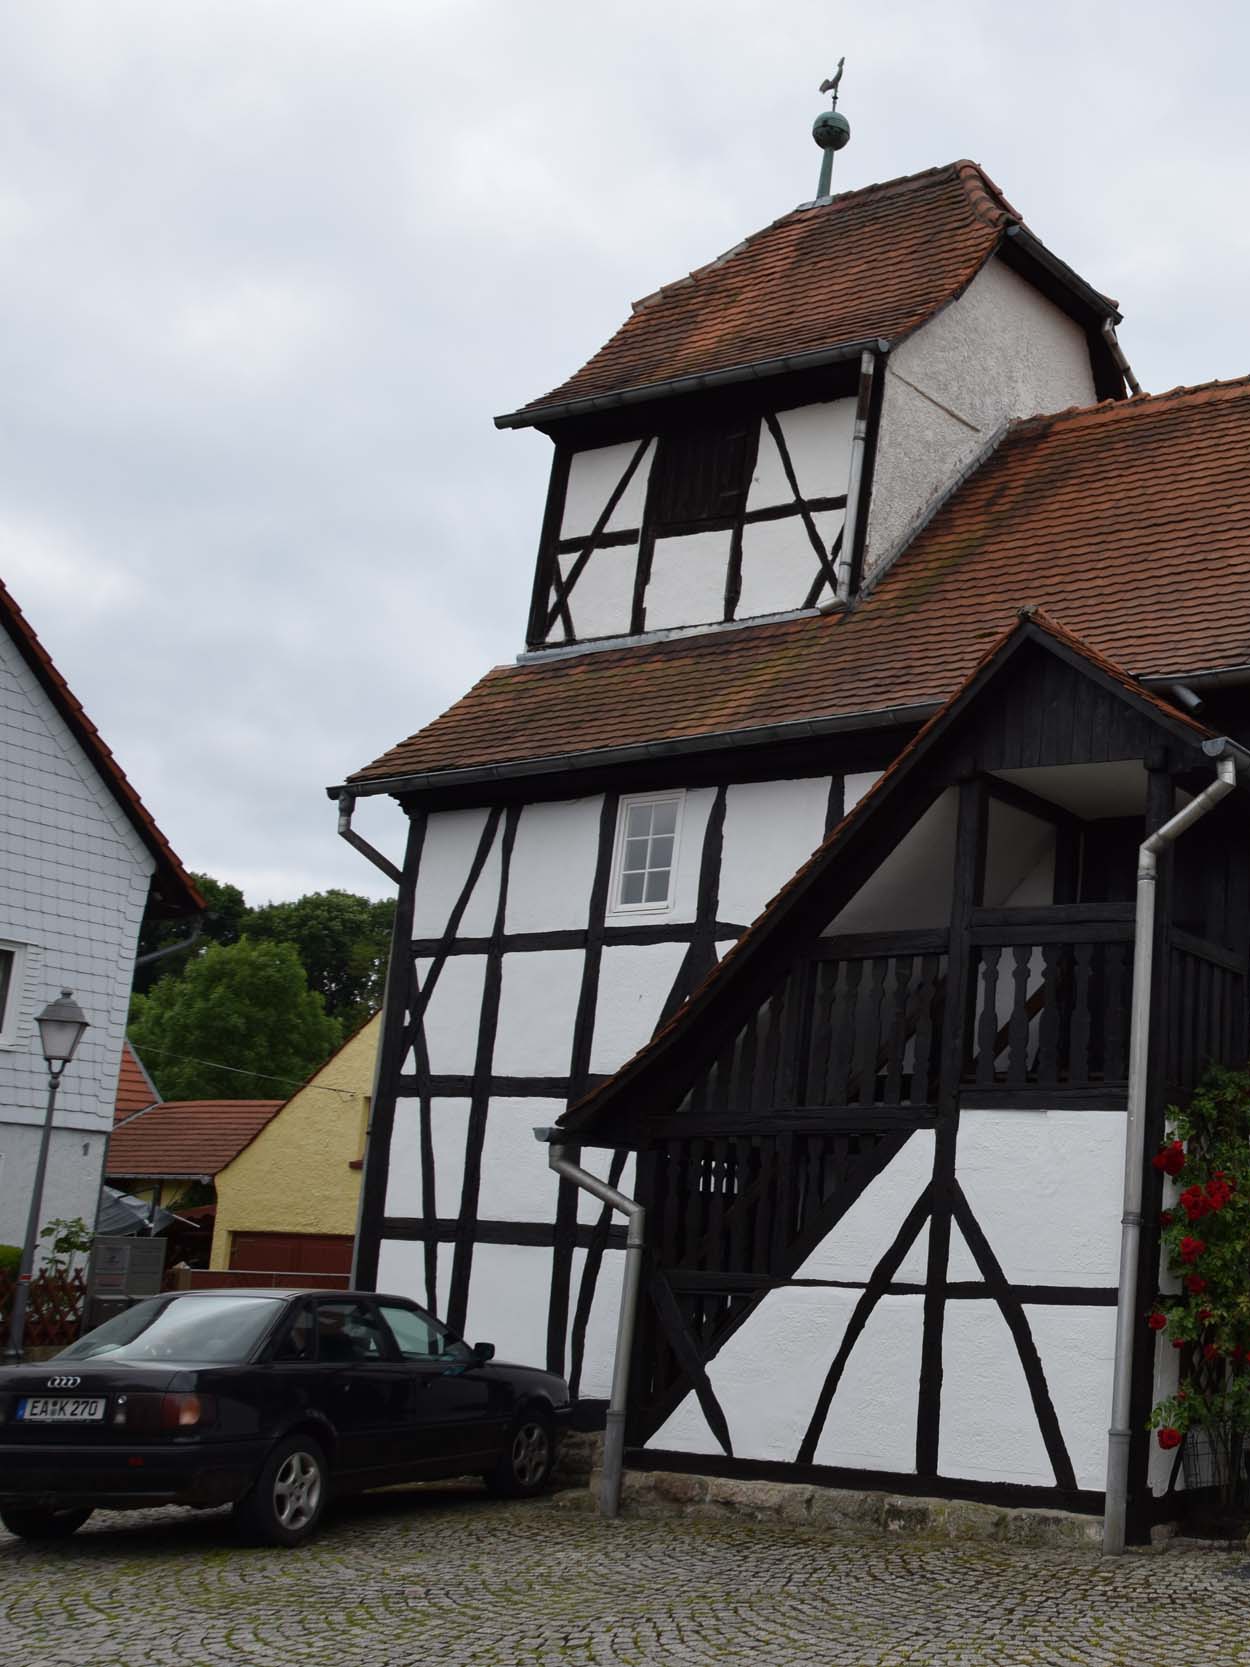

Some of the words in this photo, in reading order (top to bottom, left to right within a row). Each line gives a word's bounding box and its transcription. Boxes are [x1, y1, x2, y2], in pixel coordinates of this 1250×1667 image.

[30, 1400, 49, 1417] EA
[57, 1400, 69, 1417] K
[70, 1400, 99, 1417] 270
